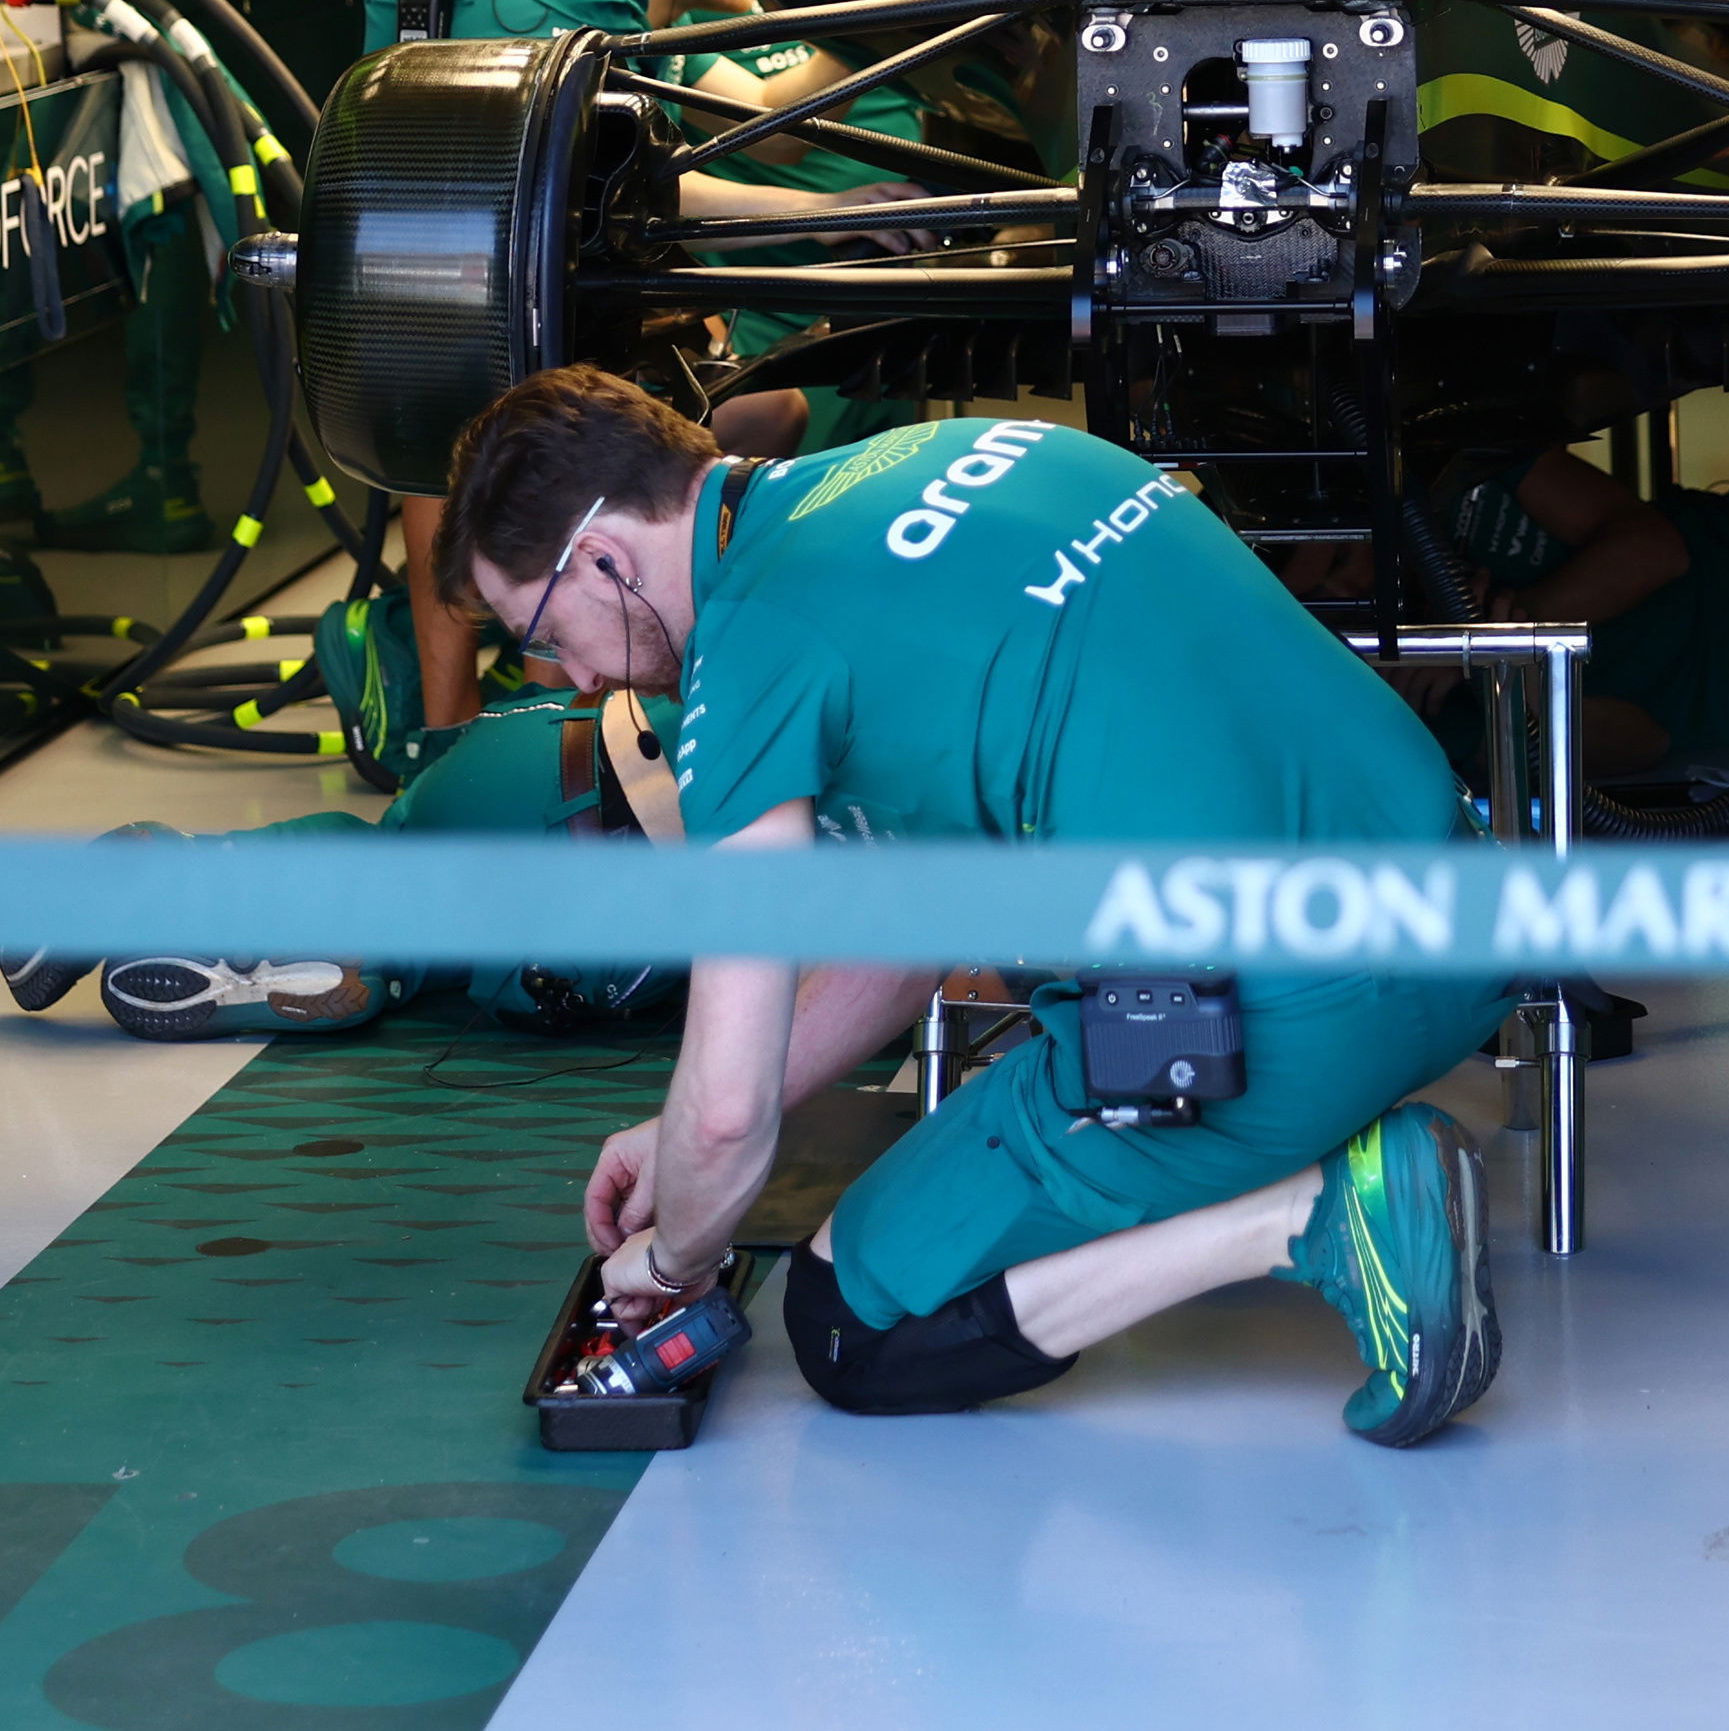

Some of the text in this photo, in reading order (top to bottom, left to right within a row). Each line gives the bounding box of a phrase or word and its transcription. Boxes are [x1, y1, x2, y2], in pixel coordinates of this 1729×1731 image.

[755, 44, 810, 74] BOSS
[768, 458, 796, 480] BO
[886, 419, 1057, 559] aram
[1071, 473, 1187, 564] Hon
[1084, 855, 1457, 959] ASTON
